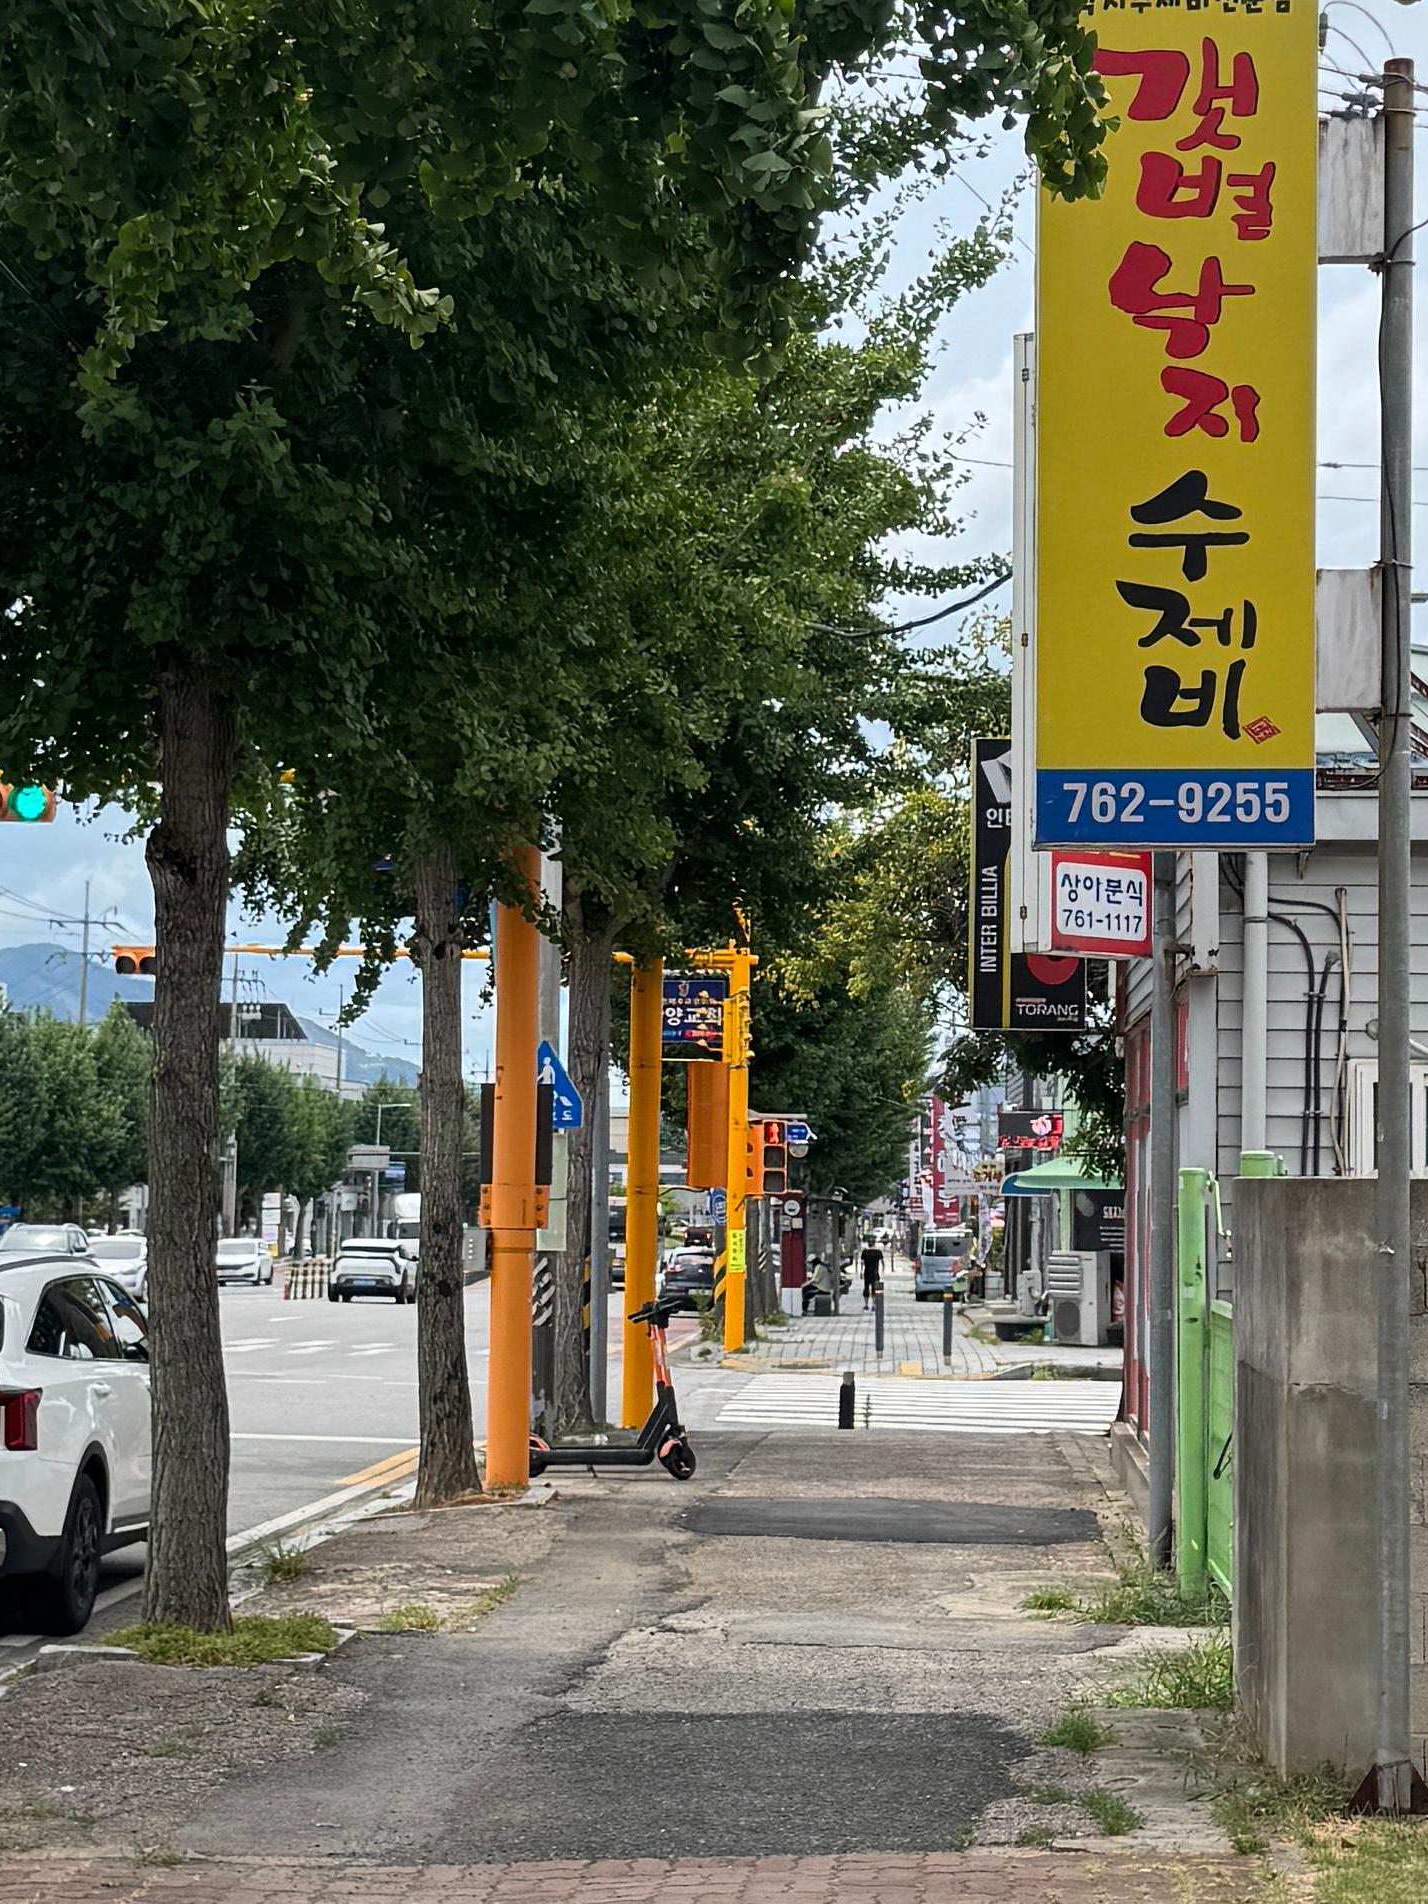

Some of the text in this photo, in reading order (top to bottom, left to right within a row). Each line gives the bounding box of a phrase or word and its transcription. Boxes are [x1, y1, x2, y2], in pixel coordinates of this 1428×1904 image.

[1062, 781, 1291, 825] 762-9255
[980, 865, 998, 973] INTER BILLIA
[1062, 908, 1143, 934] 761-1117
[1016, 1004, 1079, 1016] TORANG
